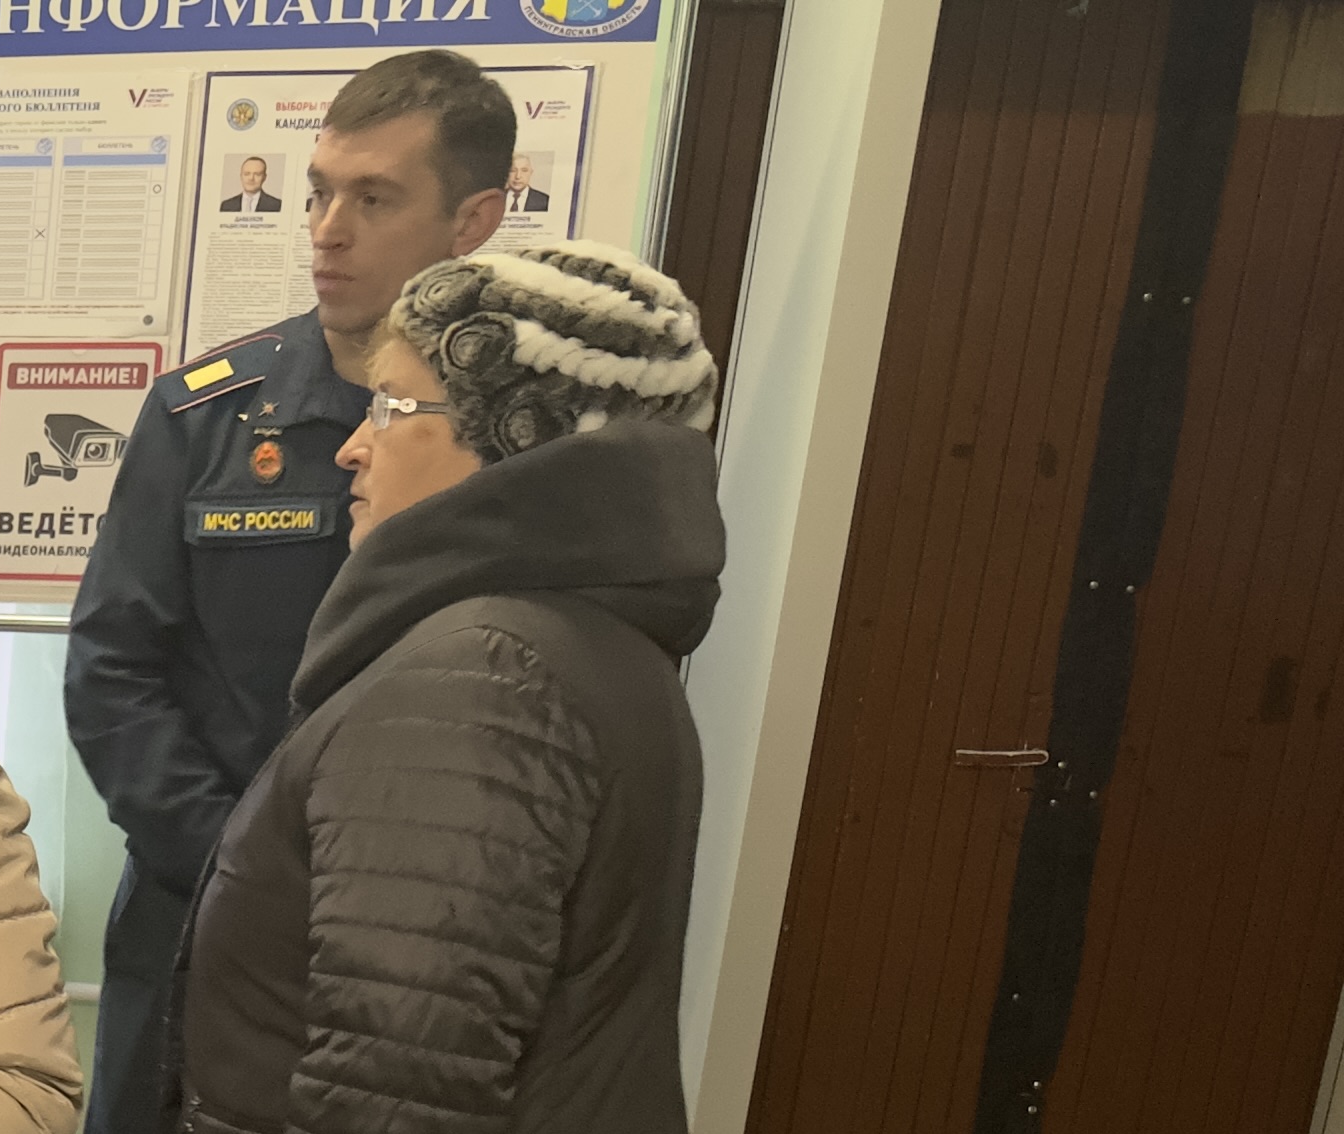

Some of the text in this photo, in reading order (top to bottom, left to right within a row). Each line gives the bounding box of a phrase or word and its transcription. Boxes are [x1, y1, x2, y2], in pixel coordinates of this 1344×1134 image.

[524, 5, 642, 36] ЛЕНИНГРАДСКАЯ ОБЛАСТЬ
[25, 101, 101, 113] БЮЛЛЕТЕНЯ
[275, 101, 318, 112] ВЫБОРЫ
[275, 118, 324, 130] КАНДИД
[15, 367, 139, 385] ВНИМАНИЕ!
[203, 509, 314, 531] МЧС РОССИИ
